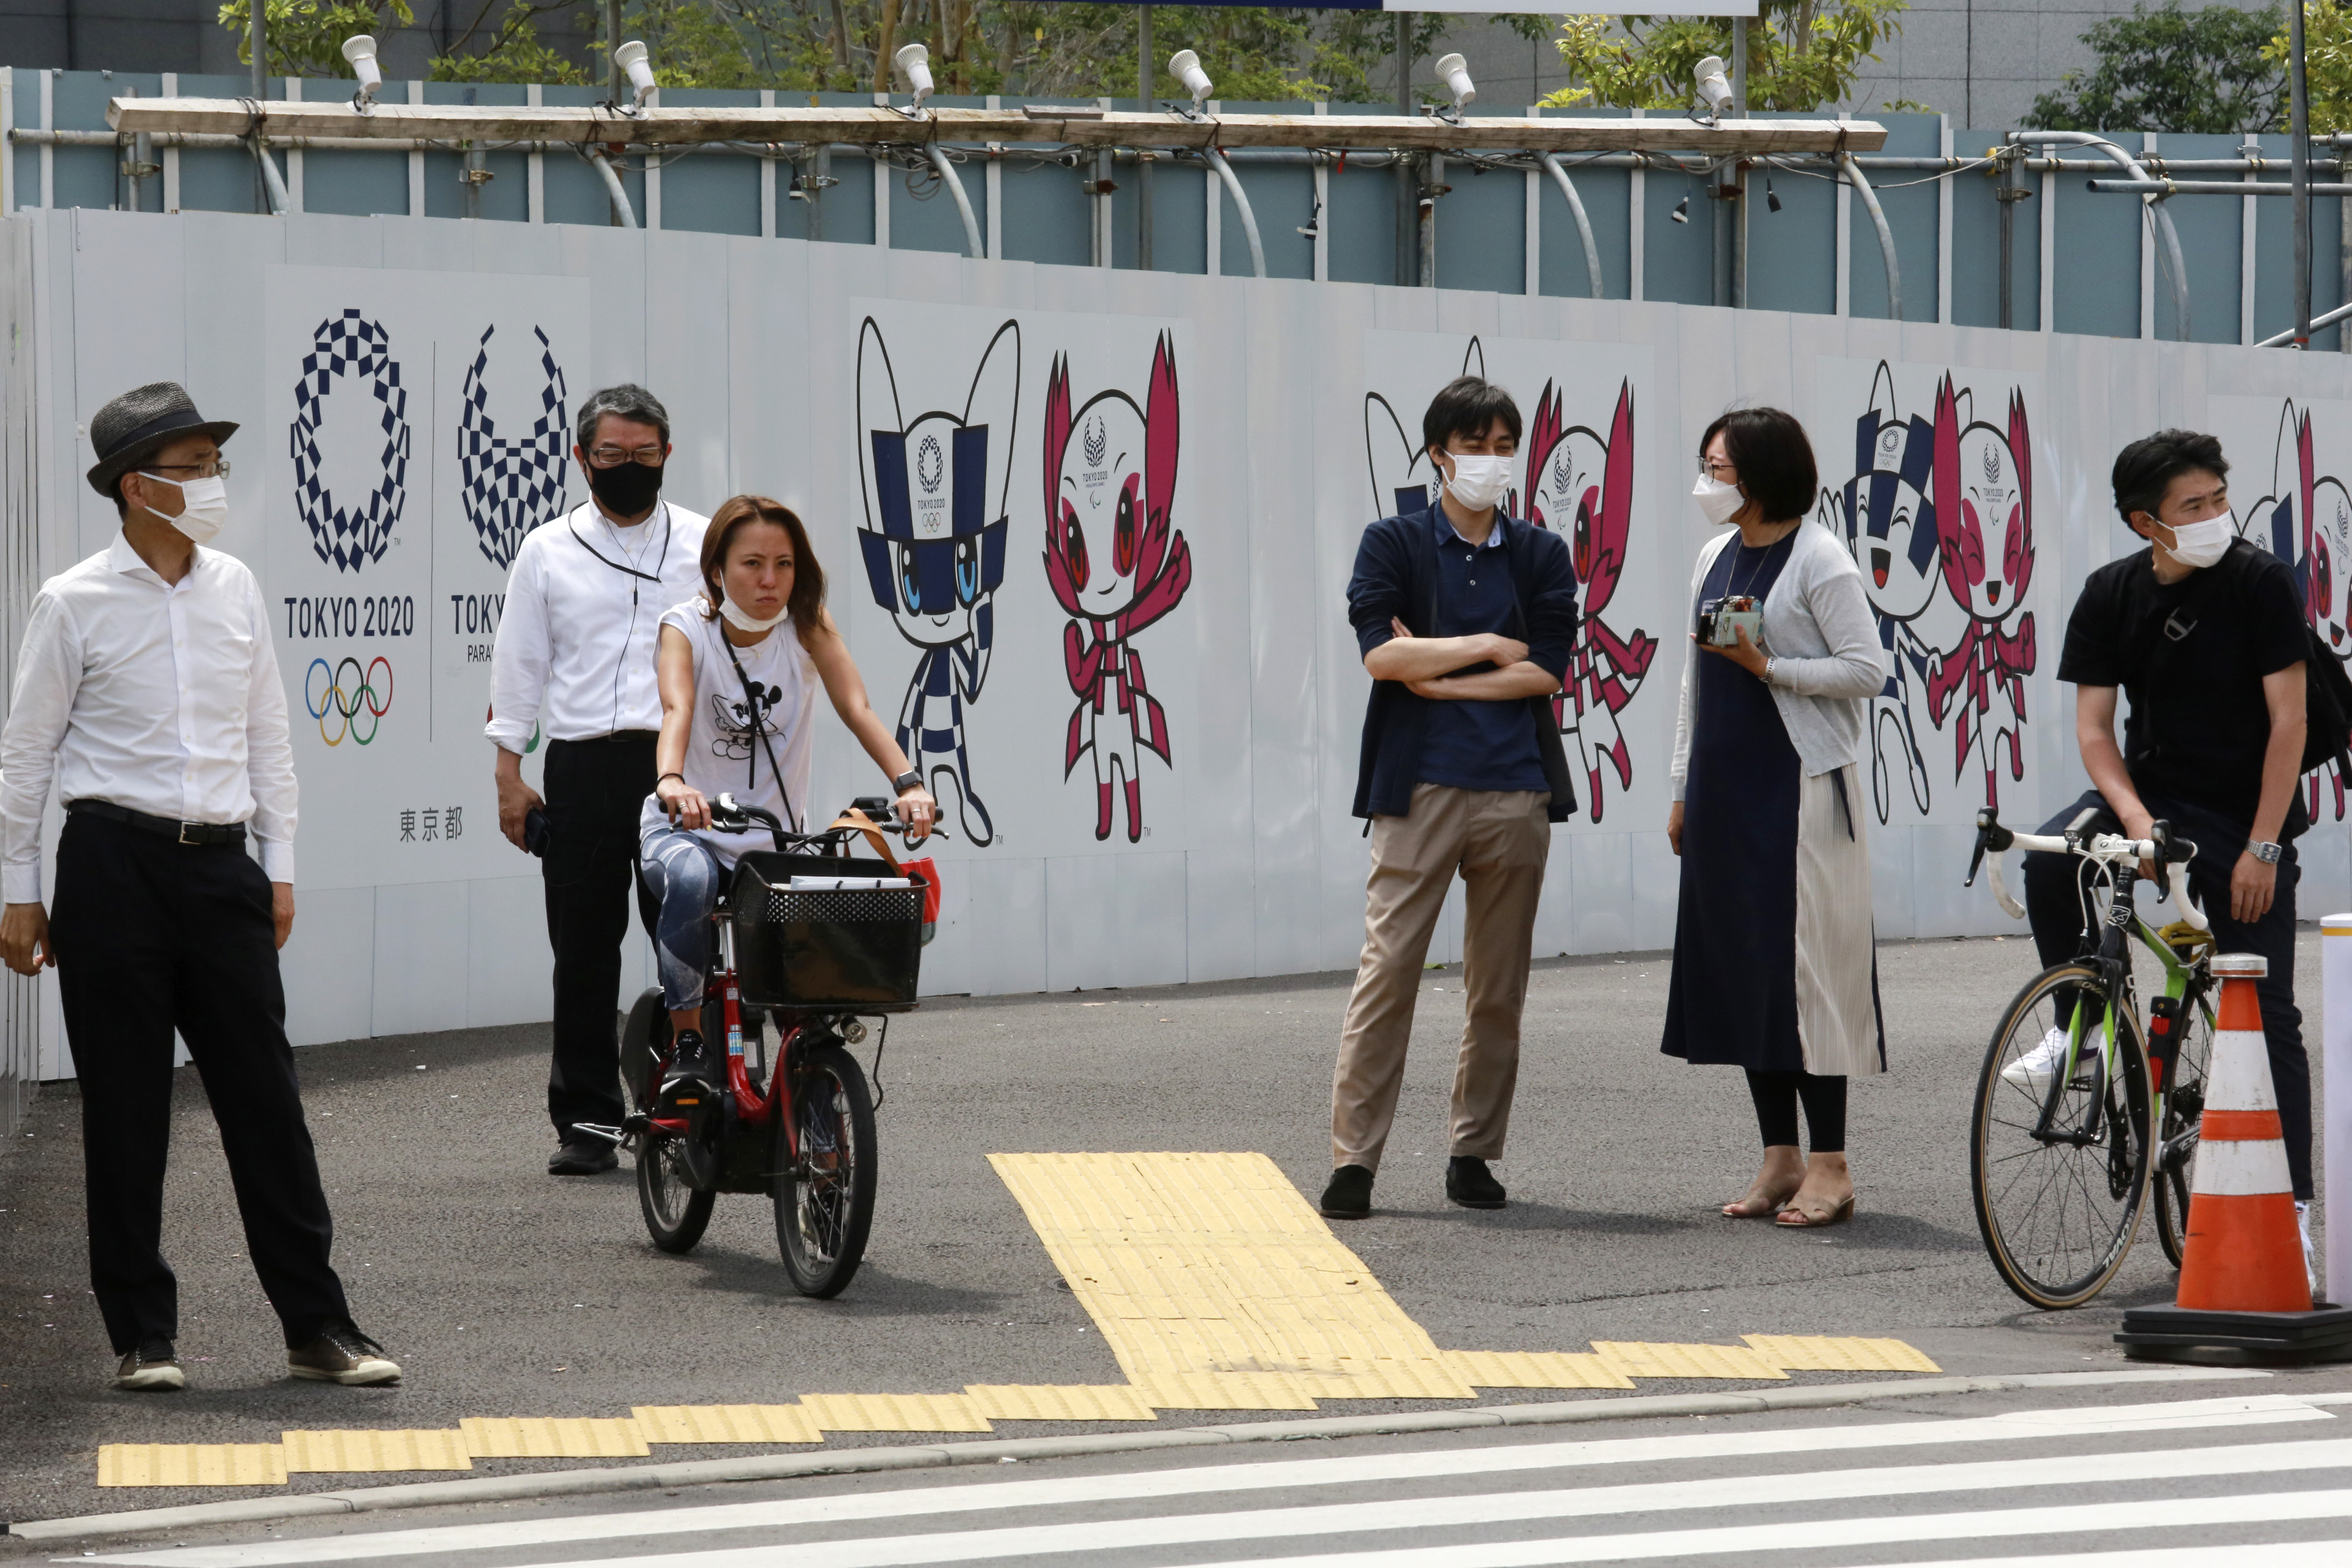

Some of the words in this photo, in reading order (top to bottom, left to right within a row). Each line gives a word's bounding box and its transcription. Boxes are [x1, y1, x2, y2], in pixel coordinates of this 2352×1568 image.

[1083, 472, 1096, 482] TOKYO
[1097, 471, 1108, 480] 2020
[918, 500, 933, 510] TOKYO
[934, 498, 945, 509] 2020
[394, 537, 401, 546] TM
[285, 597, 357, 638] TOKYO
[364, 596, 413, 637] 2020
[451, 594, 506, 634] TOKY
[468, 644, 493, 662] PARA
[400, 806, 463, 843] 東京都
[1143, 827, 1151, 838] TM
[995, 835, 1003, 846] TM
[2102, 1223, 2130, 1269] OVAL
